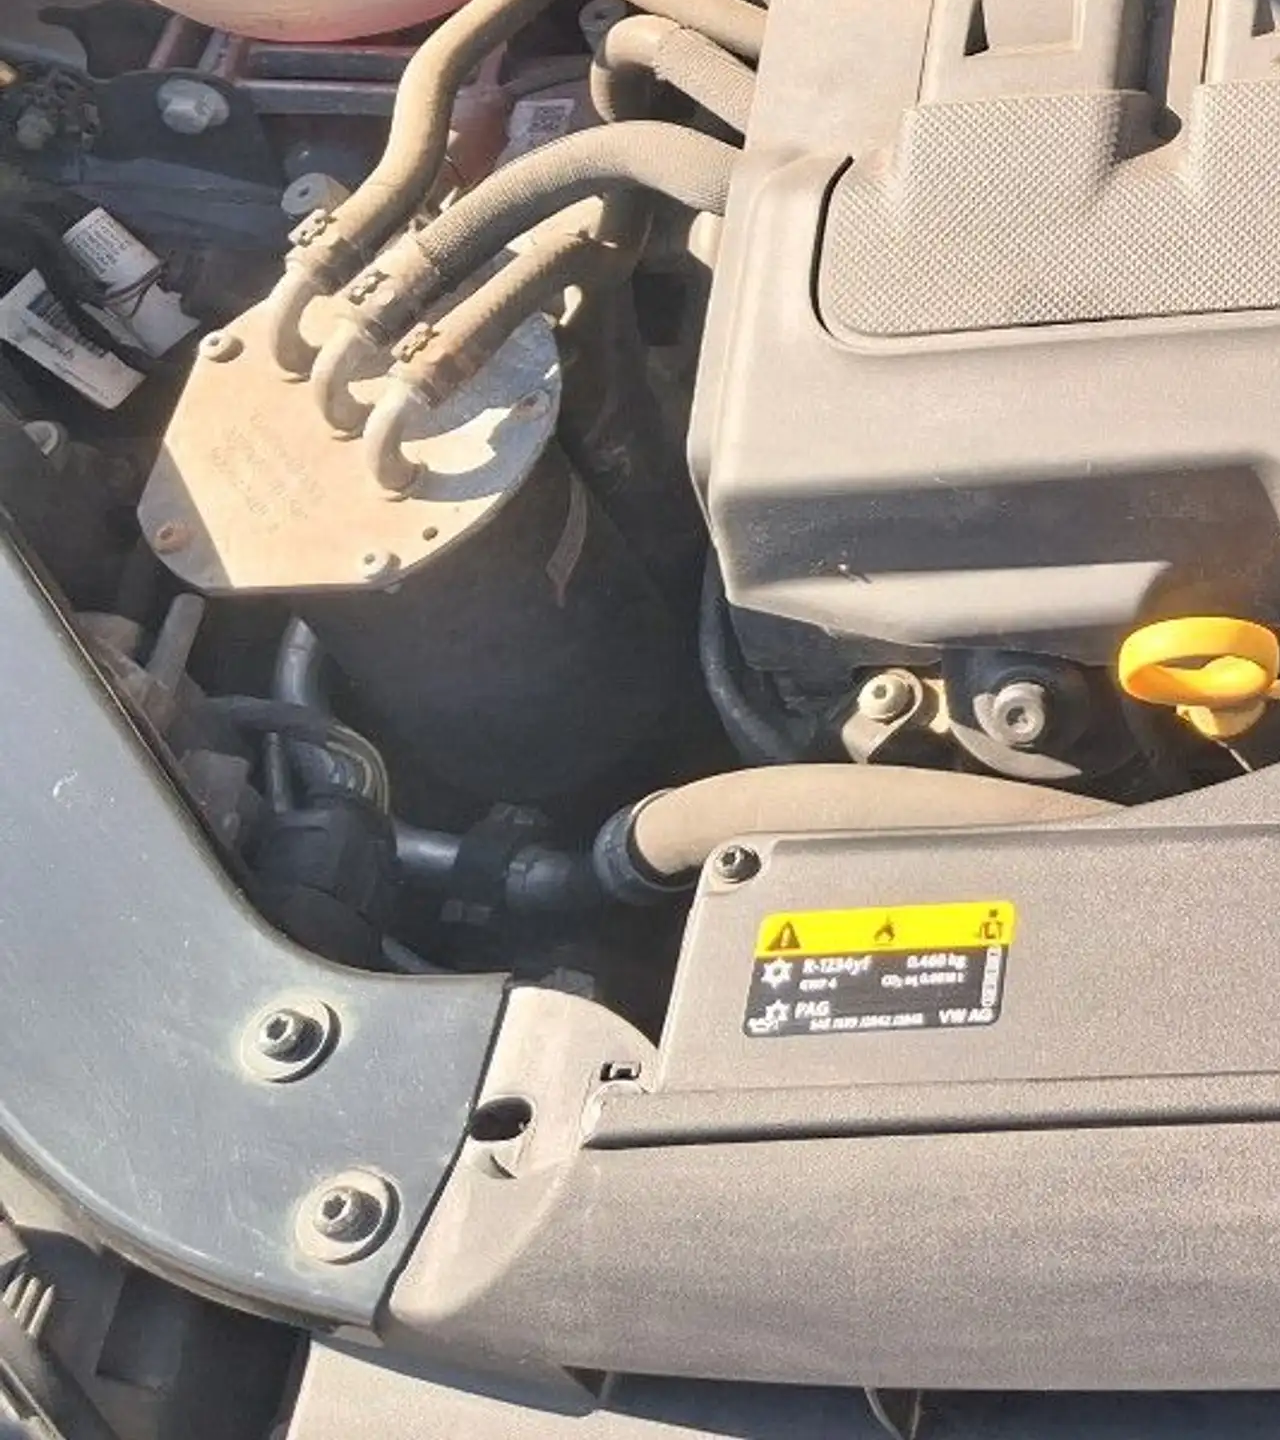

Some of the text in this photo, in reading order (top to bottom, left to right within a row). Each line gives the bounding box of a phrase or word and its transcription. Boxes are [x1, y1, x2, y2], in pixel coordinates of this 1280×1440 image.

[795, 999, 830, 1019] PAG
[938, 1007, 994, 1024] VW AG
